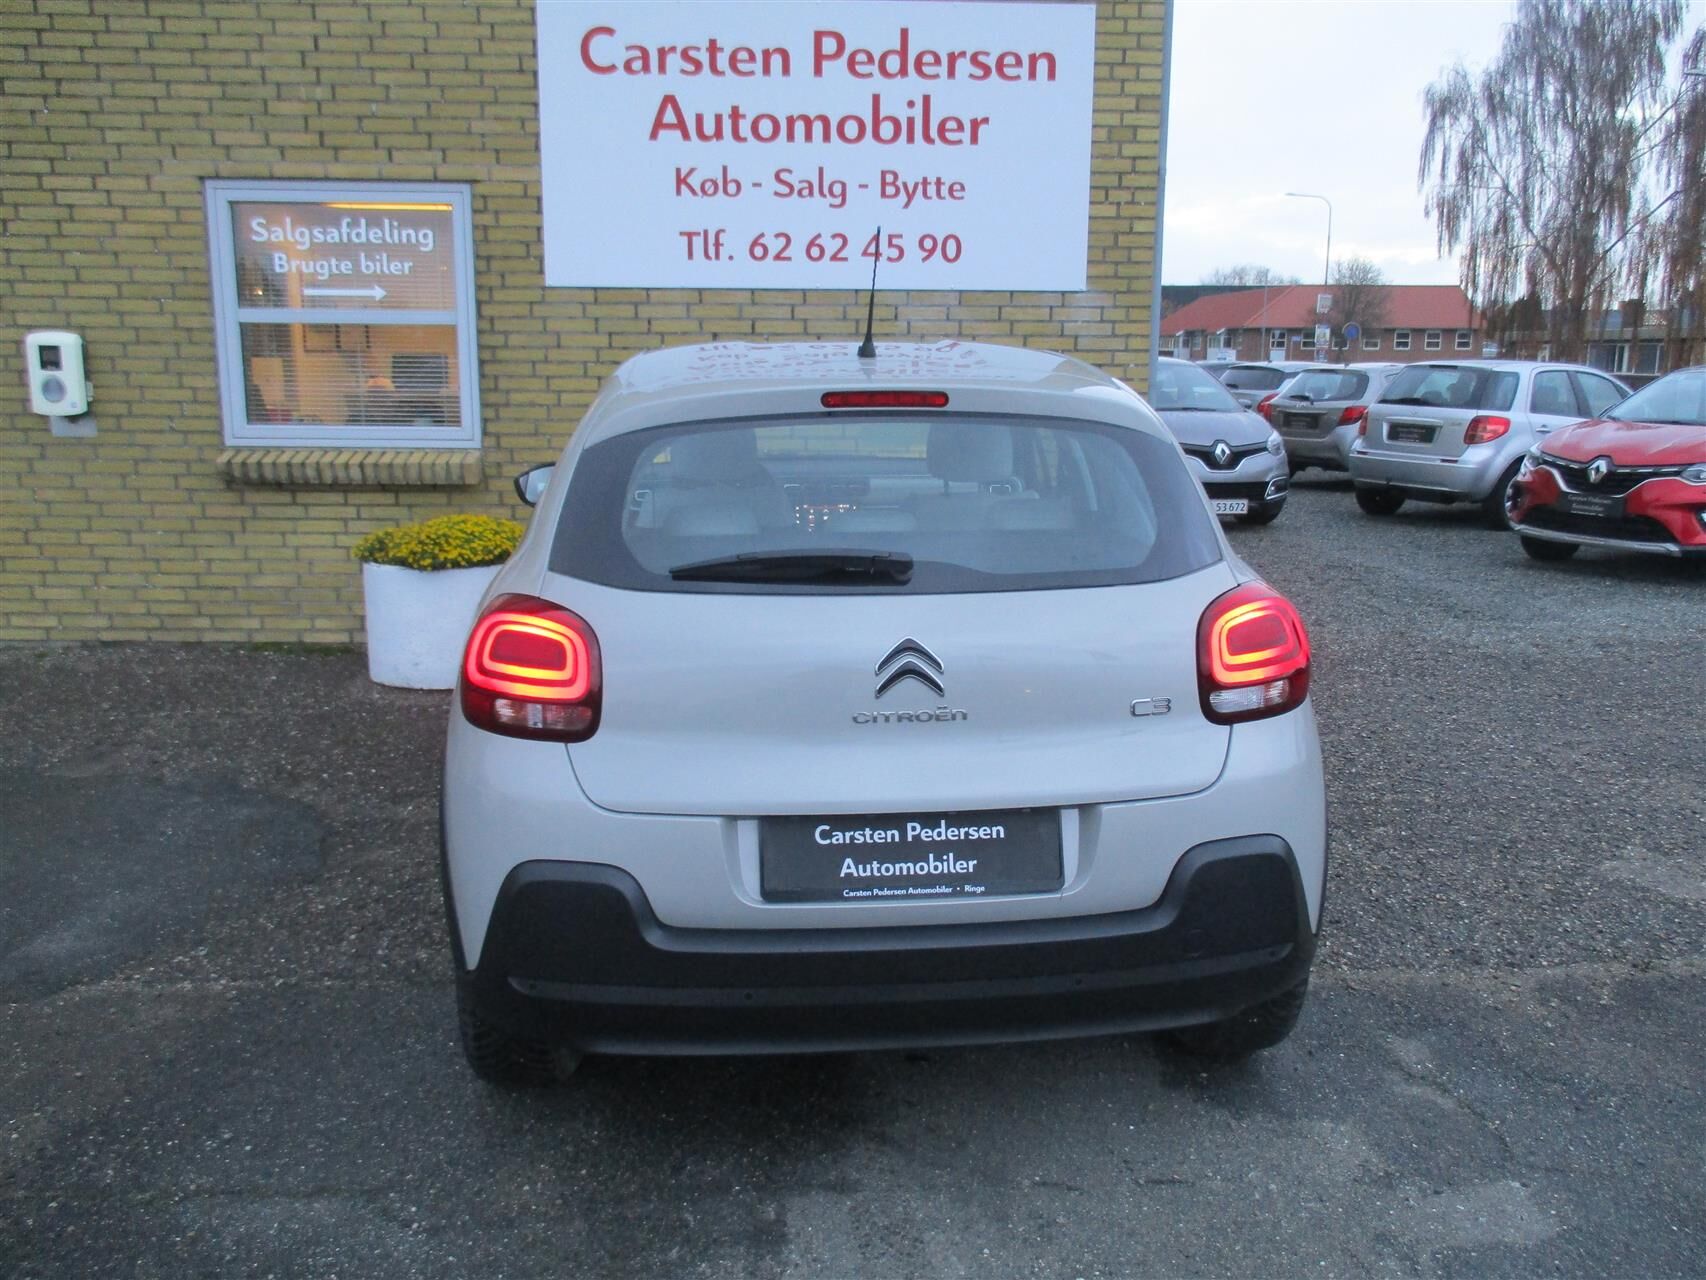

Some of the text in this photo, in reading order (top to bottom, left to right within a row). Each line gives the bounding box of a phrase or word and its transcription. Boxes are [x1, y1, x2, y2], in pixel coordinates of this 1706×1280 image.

[580, 26, 1057, 82] Carsten Pedersen
[649, 93, 990, 147] Automobiler
[674, 166, 743, 199] Køb
[773, 167, 848, 209] Salg
[880, 169, 966, 209] Bytte
[251, 216, 435, 252] Salgsafdeling
[680, 229, 963, 264] Tlf. 62 62 45 90
[274, 252, 414, 280] Brugte biler
[1130, 696, 1172, 717] C3
[814, 819, 1005, 845] Carsten Pedersen
[839, 852, 978, 878] Automobiler
[843, 884, 986, 897] Carsten Pedersen Automobiler Ringe
